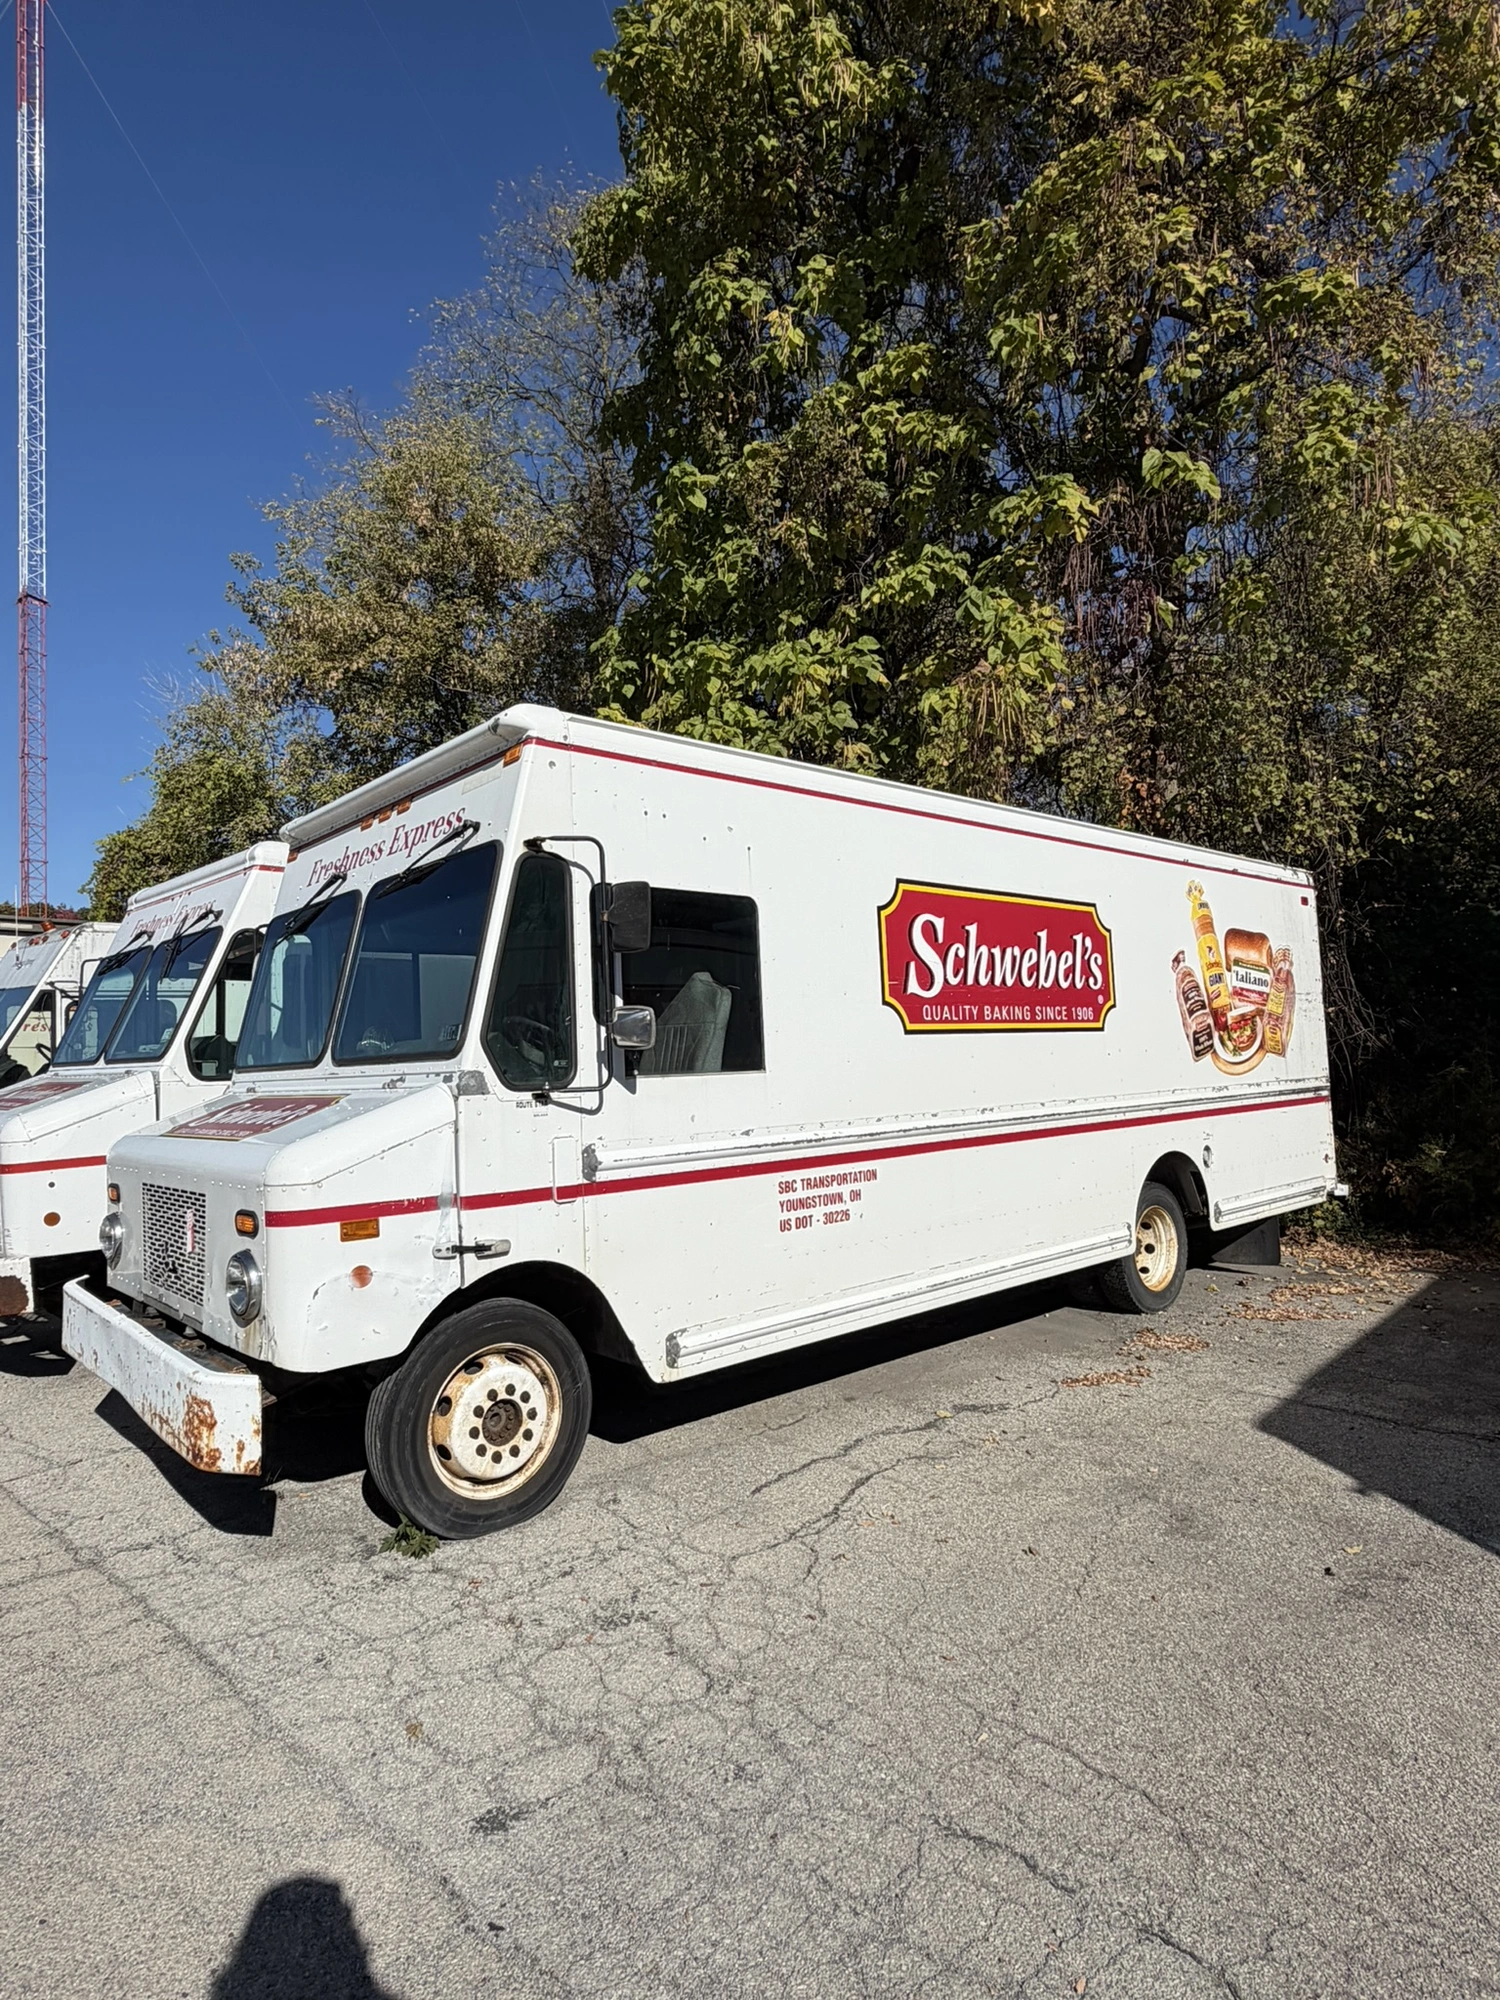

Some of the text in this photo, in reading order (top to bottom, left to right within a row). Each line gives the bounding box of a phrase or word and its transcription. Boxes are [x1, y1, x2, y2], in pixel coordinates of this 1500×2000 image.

[306, 807, 466, 888] Freshness Express
[903, 913, 1103, 999] Schwebel's
[922, 1004, 1094, 1021] QUALITY BAKING SINCE 1906
[778, 1168, 878, 1195] SBC TRANSPORTATION
[779, 1188, 862, 1213] YOUNGSTOWN, OH
[779, 1217, 792, 1233] US
[795, 1214, 814, 1230] DOT
[822, 1208, 851, 1225] 30226
